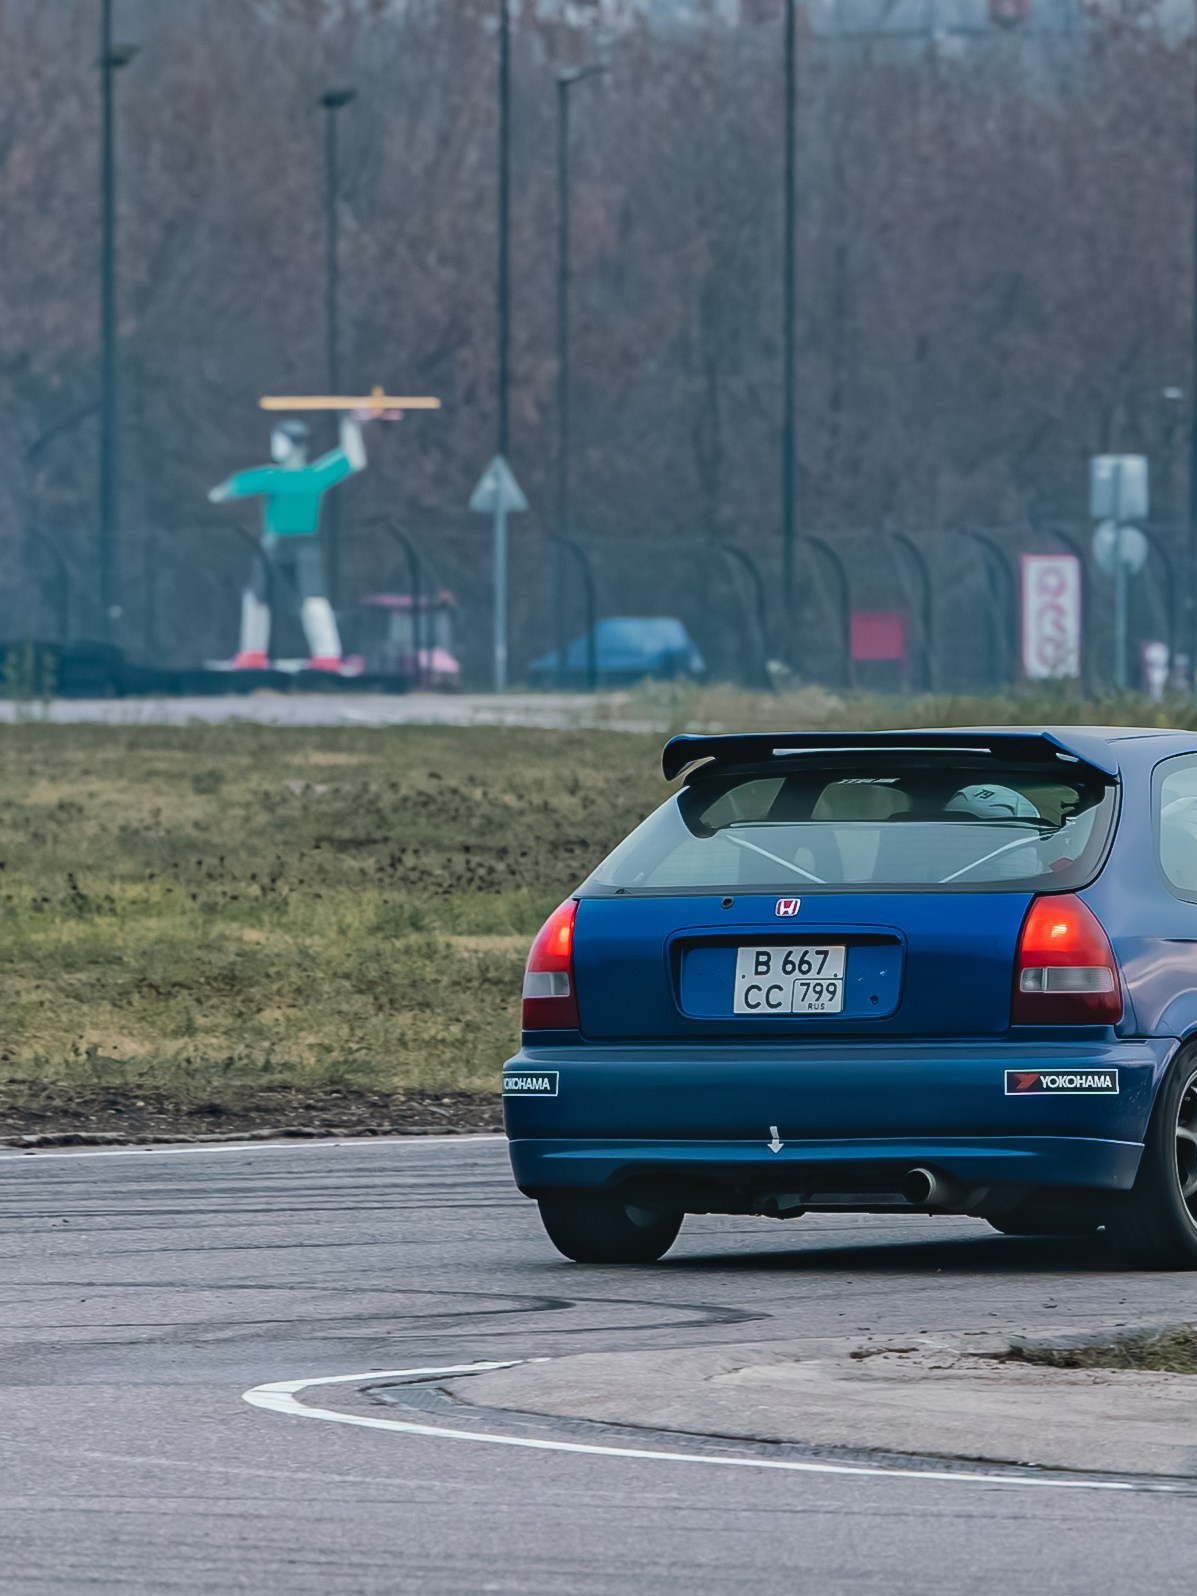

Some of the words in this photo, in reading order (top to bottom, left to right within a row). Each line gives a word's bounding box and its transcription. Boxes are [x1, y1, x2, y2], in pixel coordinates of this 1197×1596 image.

[754, 950, 772, 976] B
[781, 949, 830, 976] 667
[744, 984, 784, 1010] CC
[799, 982, 838, 1002] 799
[807, 1002, 826, 1011] RUS
[503, 1077, 551, 1091] OKOHAMA
[1039, 1074, 1113, 1089] YOKOHAMA
